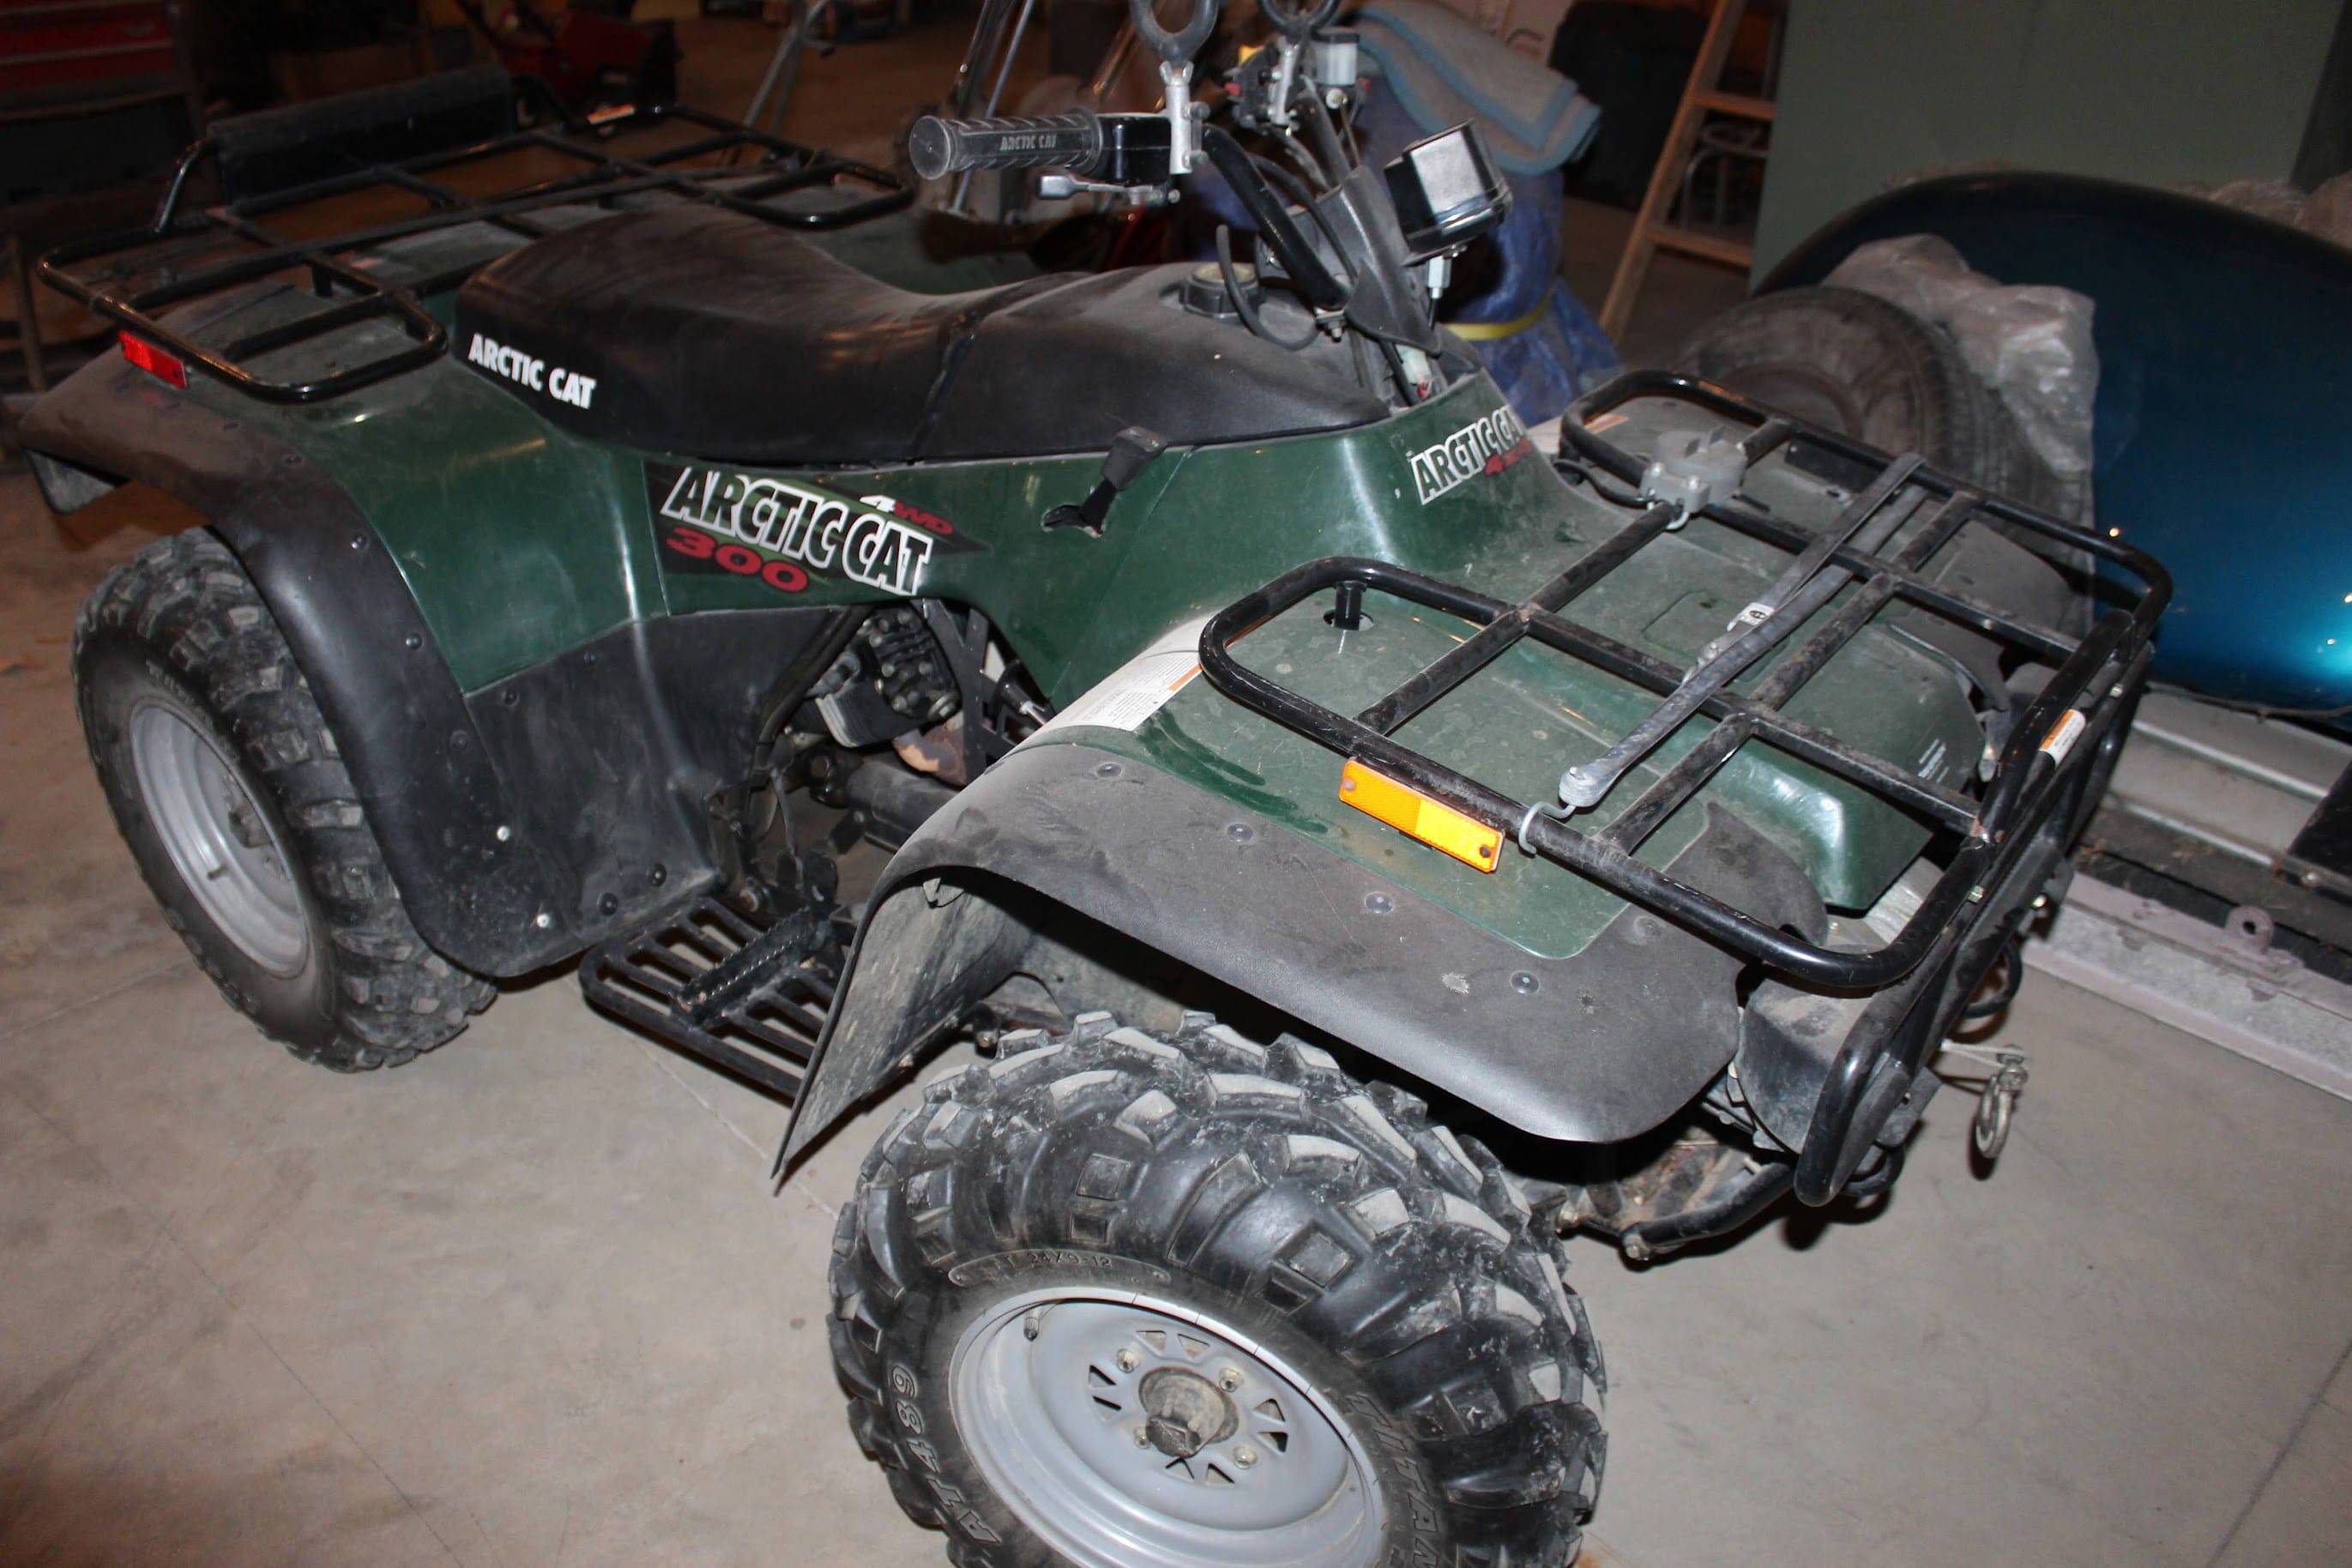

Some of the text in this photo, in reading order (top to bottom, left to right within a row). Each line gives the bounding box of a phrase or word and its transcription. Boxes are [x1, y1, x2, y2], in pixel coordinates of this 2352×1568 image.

[468, 332, 597, 410] ARCTIC CAT
[1410, 416, 1501, 505] ARCTIC
[1492, 404, 1525, 450] CA
[659, 467, 932, 596] ARCTIC CAT
[859, 494, 954, 535] 4WD
[666, 526, 809, 594] 300
